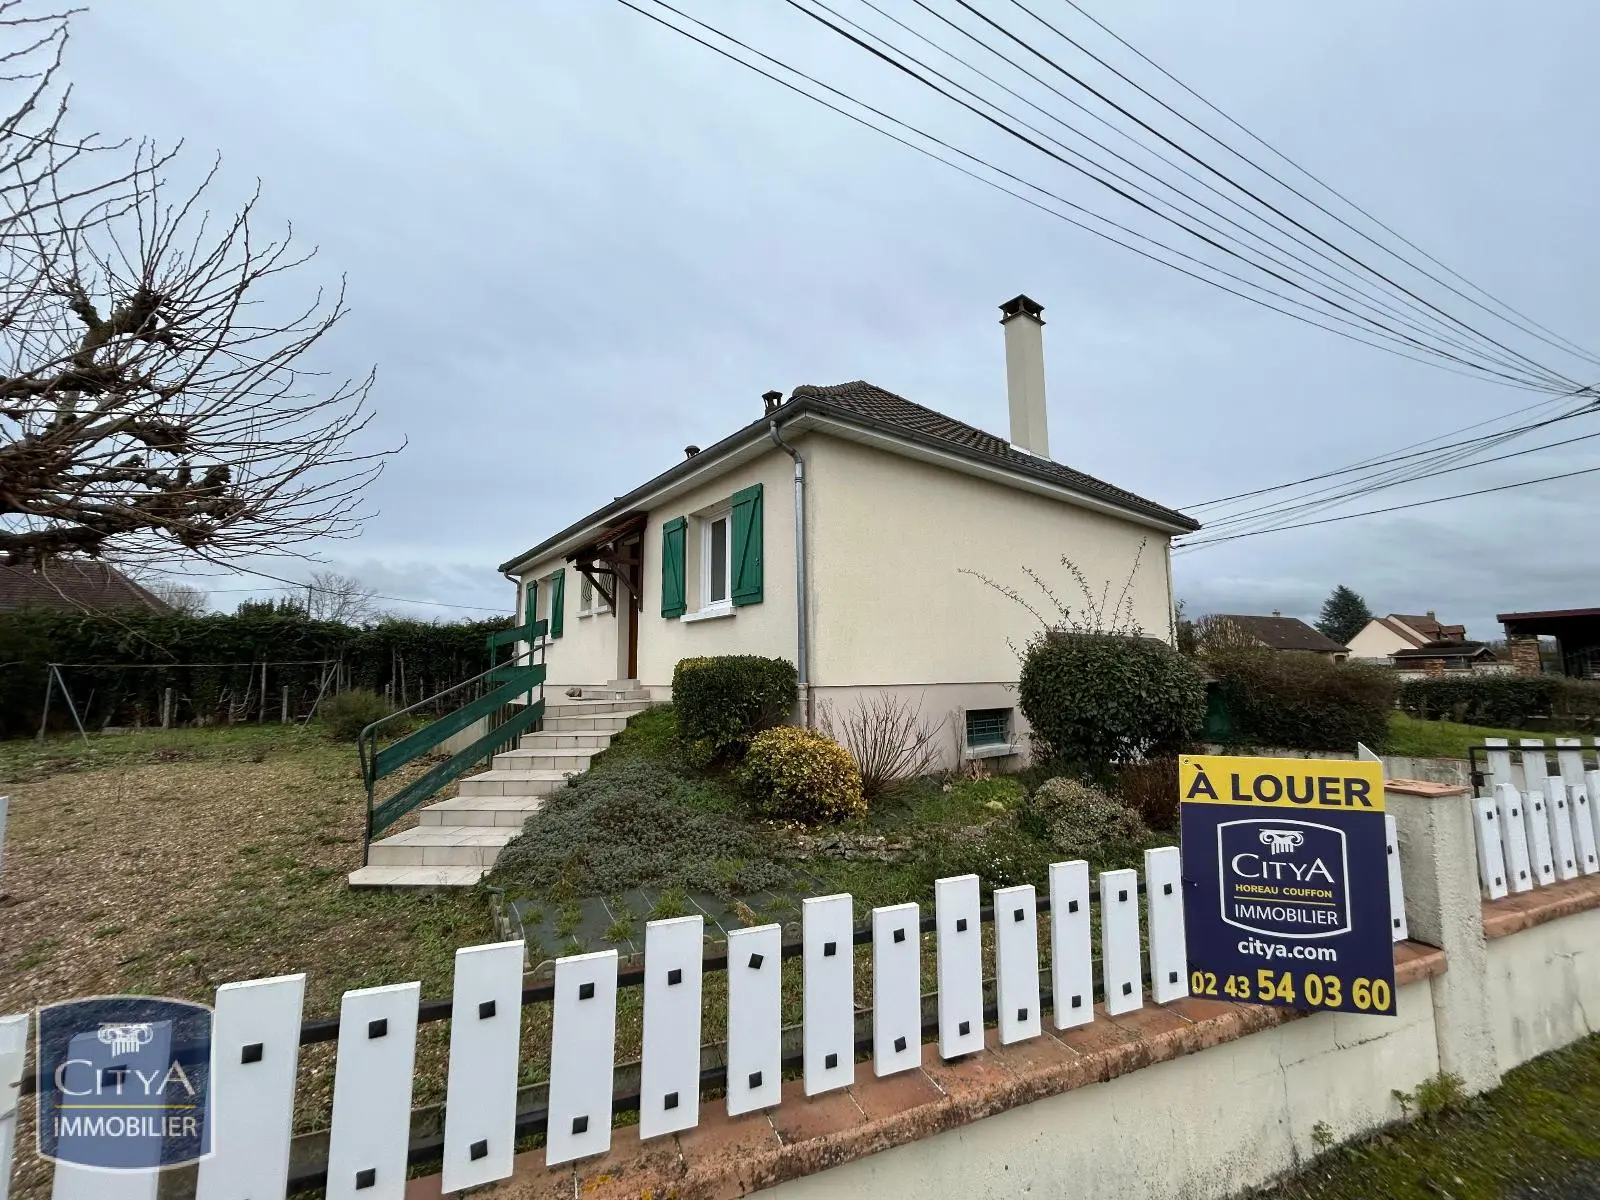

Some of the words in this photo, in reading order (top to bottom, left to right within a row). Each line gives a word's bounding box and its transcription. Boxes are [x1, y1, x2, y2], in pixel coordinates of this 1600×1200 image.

[1186, 763, 1219, 801] À
[1230, 773, 1373, 807] LOUER
[1231, 853, 1335, 884] CITYA
[1235, 884, 1279, 895] HOREAU
[1283, 887, 1333, 898] COUFFON
[1234, 904, 1339, 926] IMMOBILIER
[1237, 937, 1337, 962] citya.com
[1191, 971, 1218, 996] 02
[1224, 974, 1251, 999] 43
[1257, 969, 1296, 1003] 54
[1304, 973, 1343, 1008] 03
[1352, 977, 1391, 1011] 60
